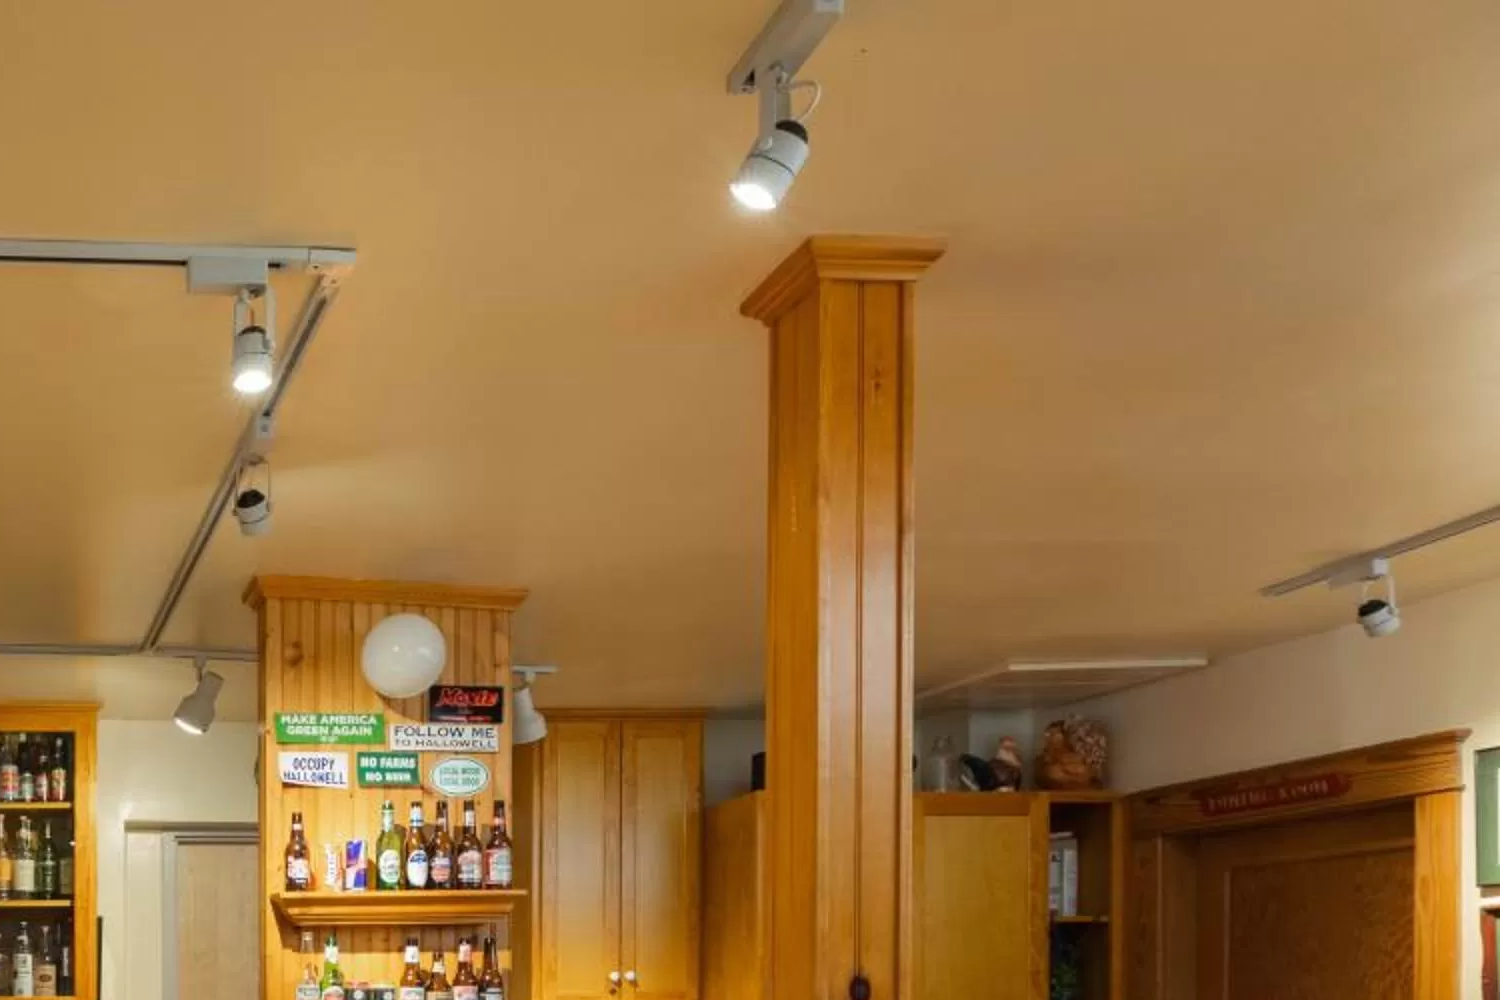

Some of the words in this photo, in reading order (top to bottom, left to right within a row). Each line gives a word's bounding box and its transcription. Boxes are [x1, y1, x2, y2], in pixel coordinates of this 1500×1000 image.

[280, 713, 317, 726] MAKE
[320, 714, 378, 726] AMERICA
[286, 725, 330, 737] GREEN
[332, 725, 374, 737] AGAIN
[394, 724, 466, 738] FOLLOW
[471, 726, 495, 740] ME
[394, 739, 413, 749] TO
[417, 739, 495, 750] HALLOWELL
[292, 757, 336, 771] OCCUPY
[360, 756, 377, 769] NO
[379, 756, 416, 770] FARMS
[283, 770, 346, 785] HALLOWELL
